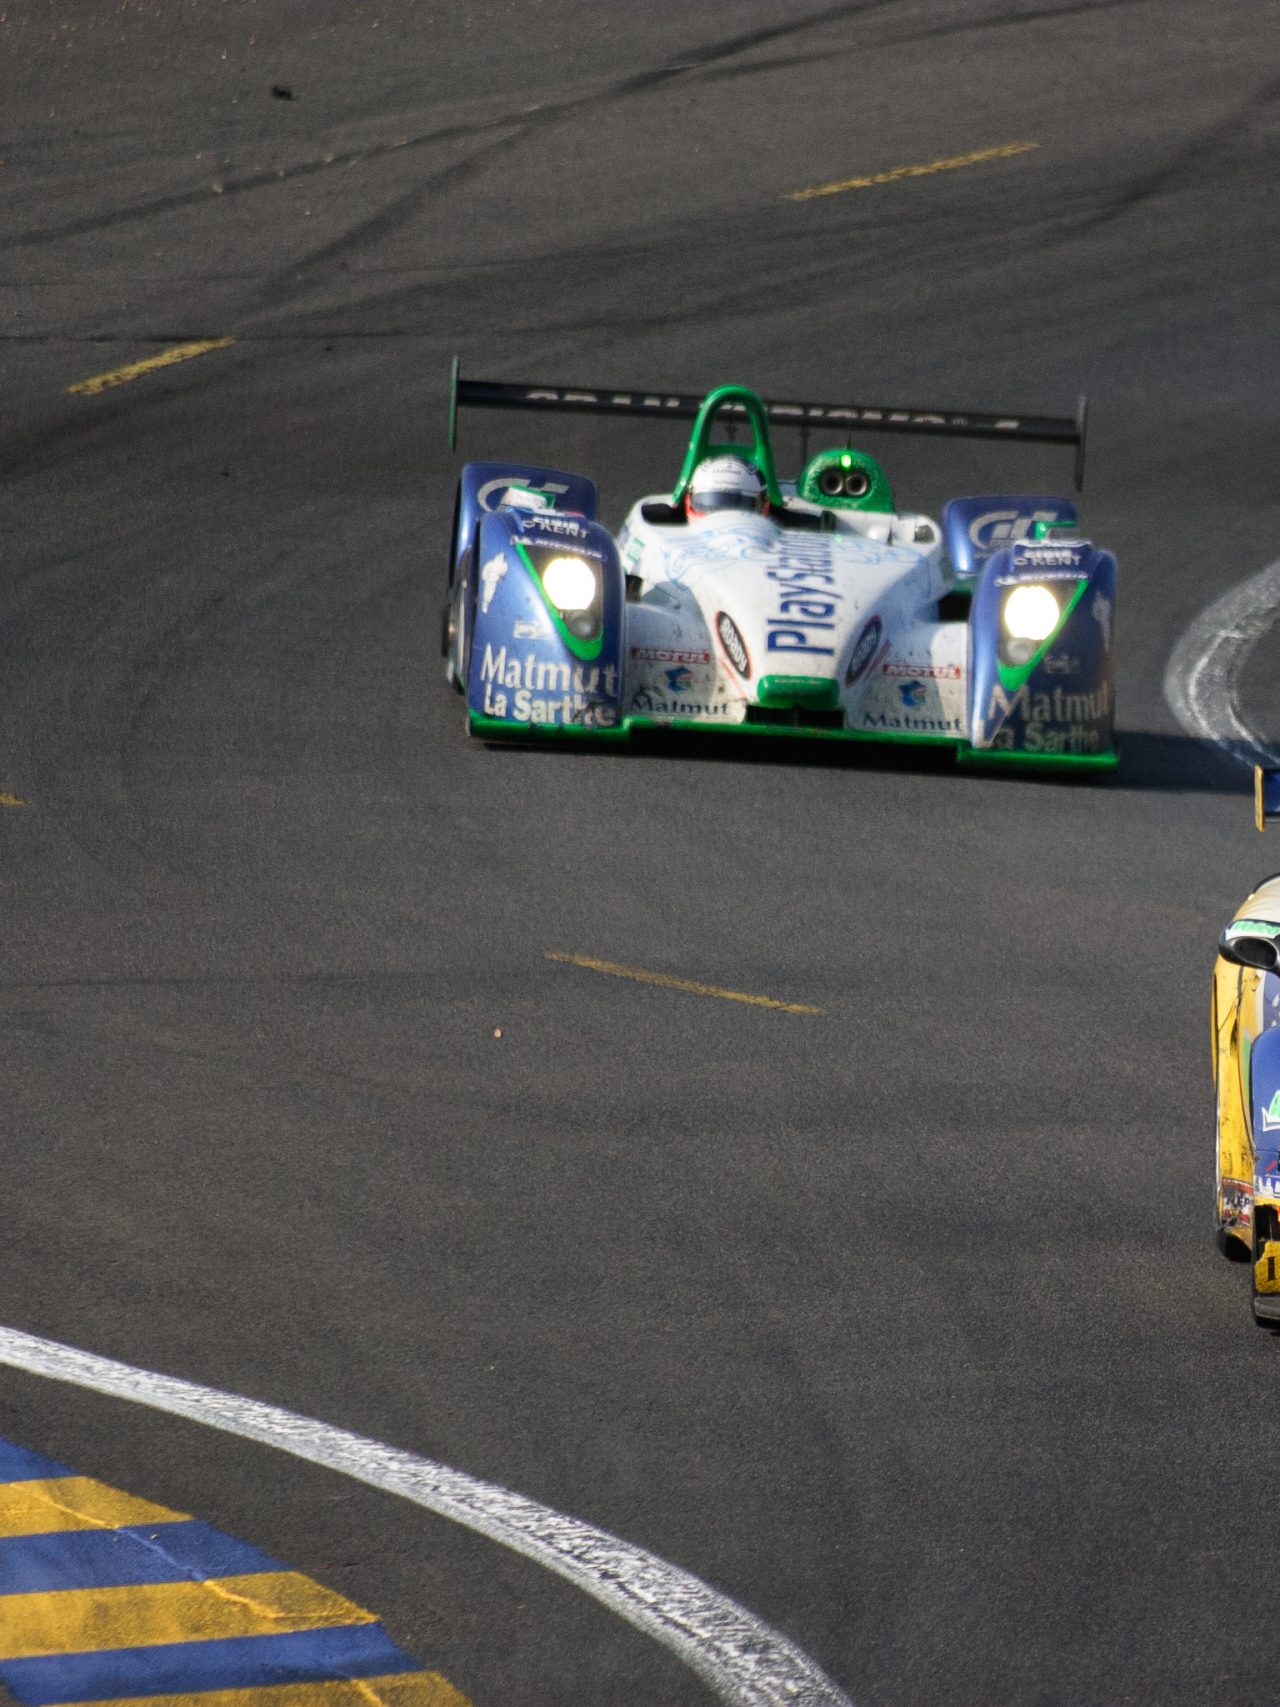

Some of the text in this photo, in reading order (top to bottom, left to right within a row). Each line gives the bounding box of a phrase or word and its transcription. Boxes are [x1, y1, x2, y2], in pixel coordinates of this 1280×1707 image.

[480, 642, 618, 698] Matmut
[484, 683, 617, 728] La Sarthe
